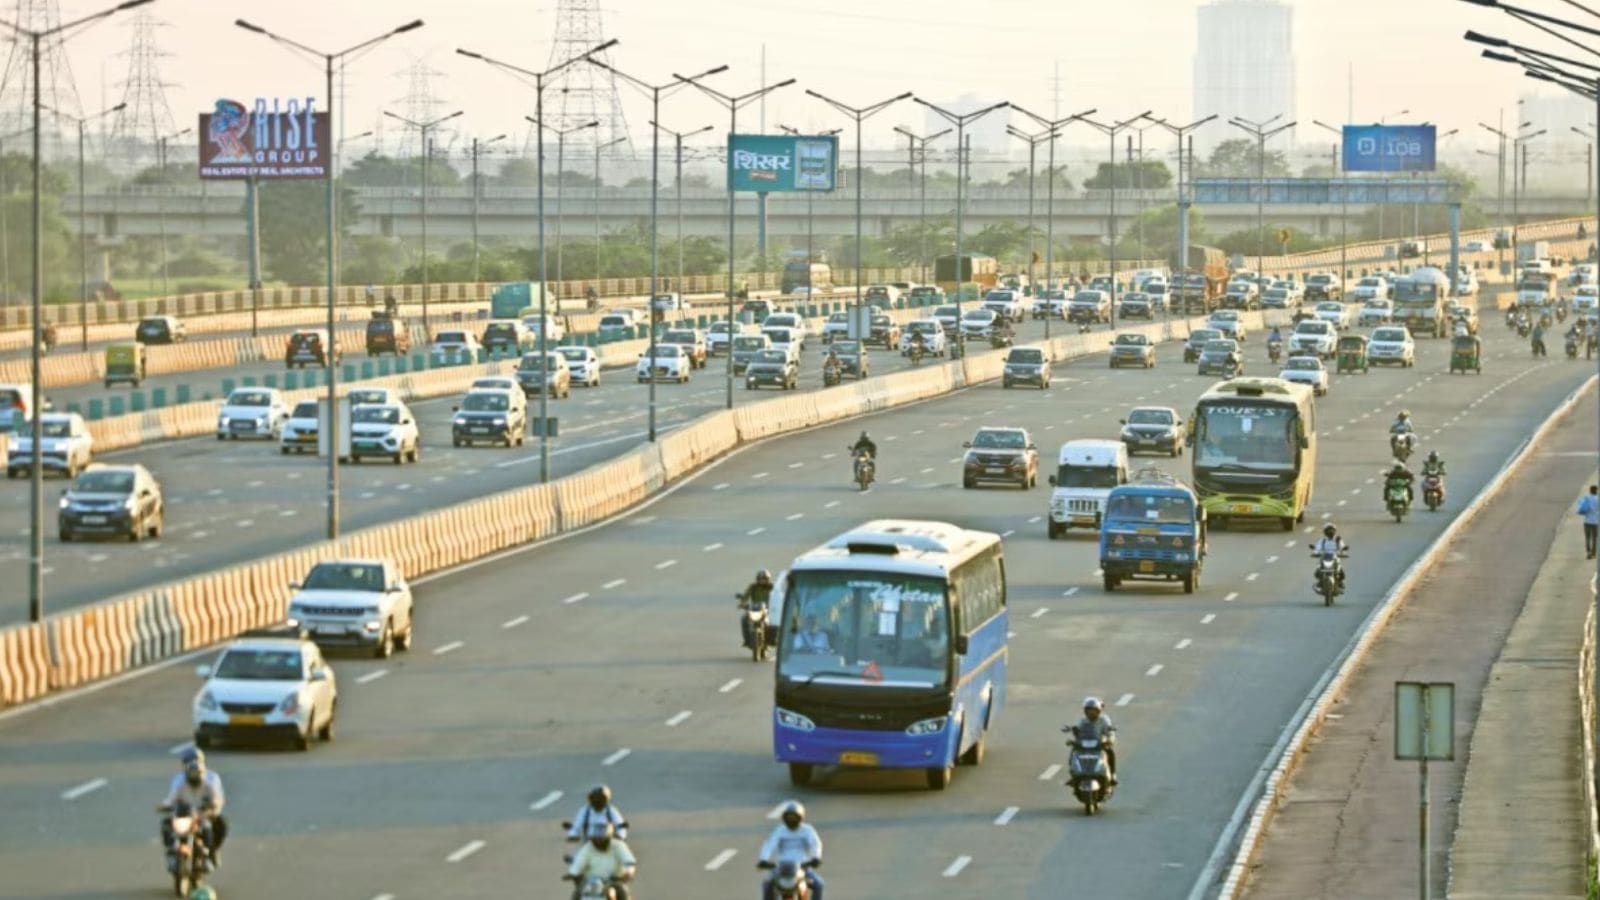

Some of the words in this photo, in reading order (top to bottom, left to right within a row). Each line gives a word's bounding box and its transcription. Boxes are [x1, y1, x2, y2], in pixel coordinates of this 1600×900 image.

[255, 97, 317, 149] RISE
[255, 150, 318, 163] GROUP
[1385, 142, 1422, 156] 108
[734, 149, 792, 170] शिखर
